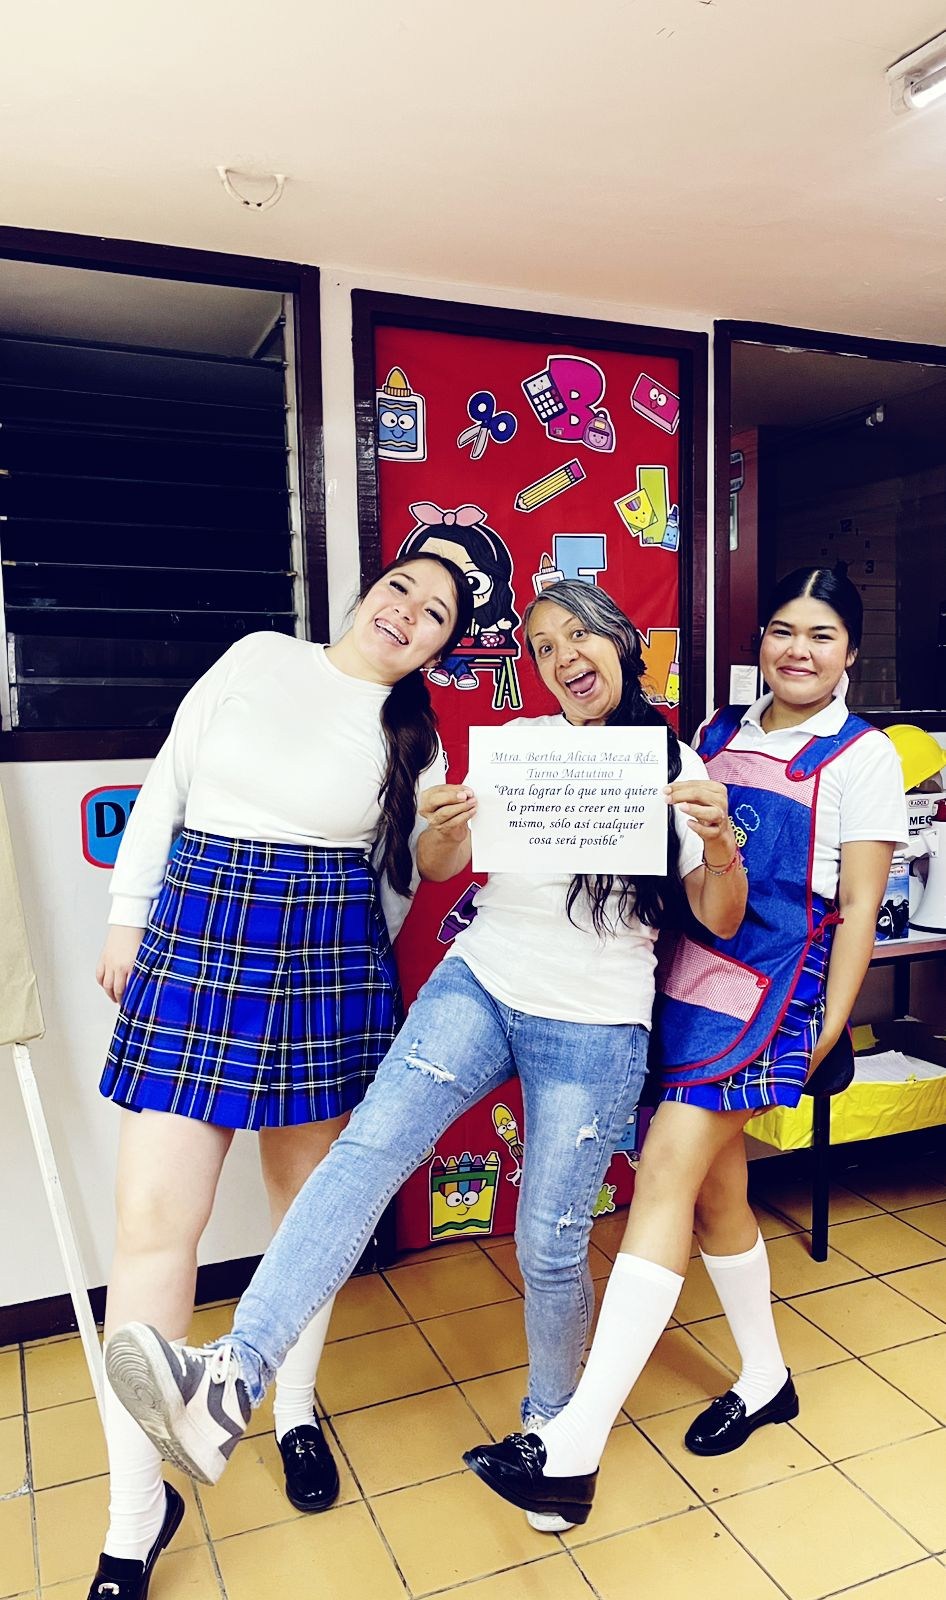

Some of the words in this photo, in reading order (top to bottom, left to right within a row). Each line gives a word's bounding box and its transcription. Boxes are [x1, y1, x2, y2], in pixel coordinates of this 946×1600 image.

[547, 357, 606, 442] B
[490, 751, 522, 764] Mtra.
[526, 751, 564, 763] Bertha
[564, 751, 598, 764] Alicia
[599, 752, 632, 764] Meza
[634, 751, 660, 764] Rdz.
[526, 768, 560, 780] Turno
[562, 768, 616, 780] Matutino
[494, 784, 526, 797] “Para
[528, 783, 563, 799] lograr
[565, 783, 576, 796] lo
[578, 787, 599, 799] que
[601, 787, 622, 797] uno
[625, 785, 659, 800] quiere
[506, 801, 518, 813] lo
[519, 803, 562, 815] primero
[564, 805, 576, 813] es
[578, 805, 606, 814] creer
[607, 805, 621, 814] en
[624, 806, 646, 814] uno
[95, 800, 136, 838] D
[508, 818, 547, 831] mismo,
[549, 817, 572, 830] sólo
[574, 819, 592, 830] así
[593, 818, 646, 833] cualquier
[528, 836, 553, 846] cosa
[554, 835, 578, 847] será
[580, 834, 626, 849] posible”
